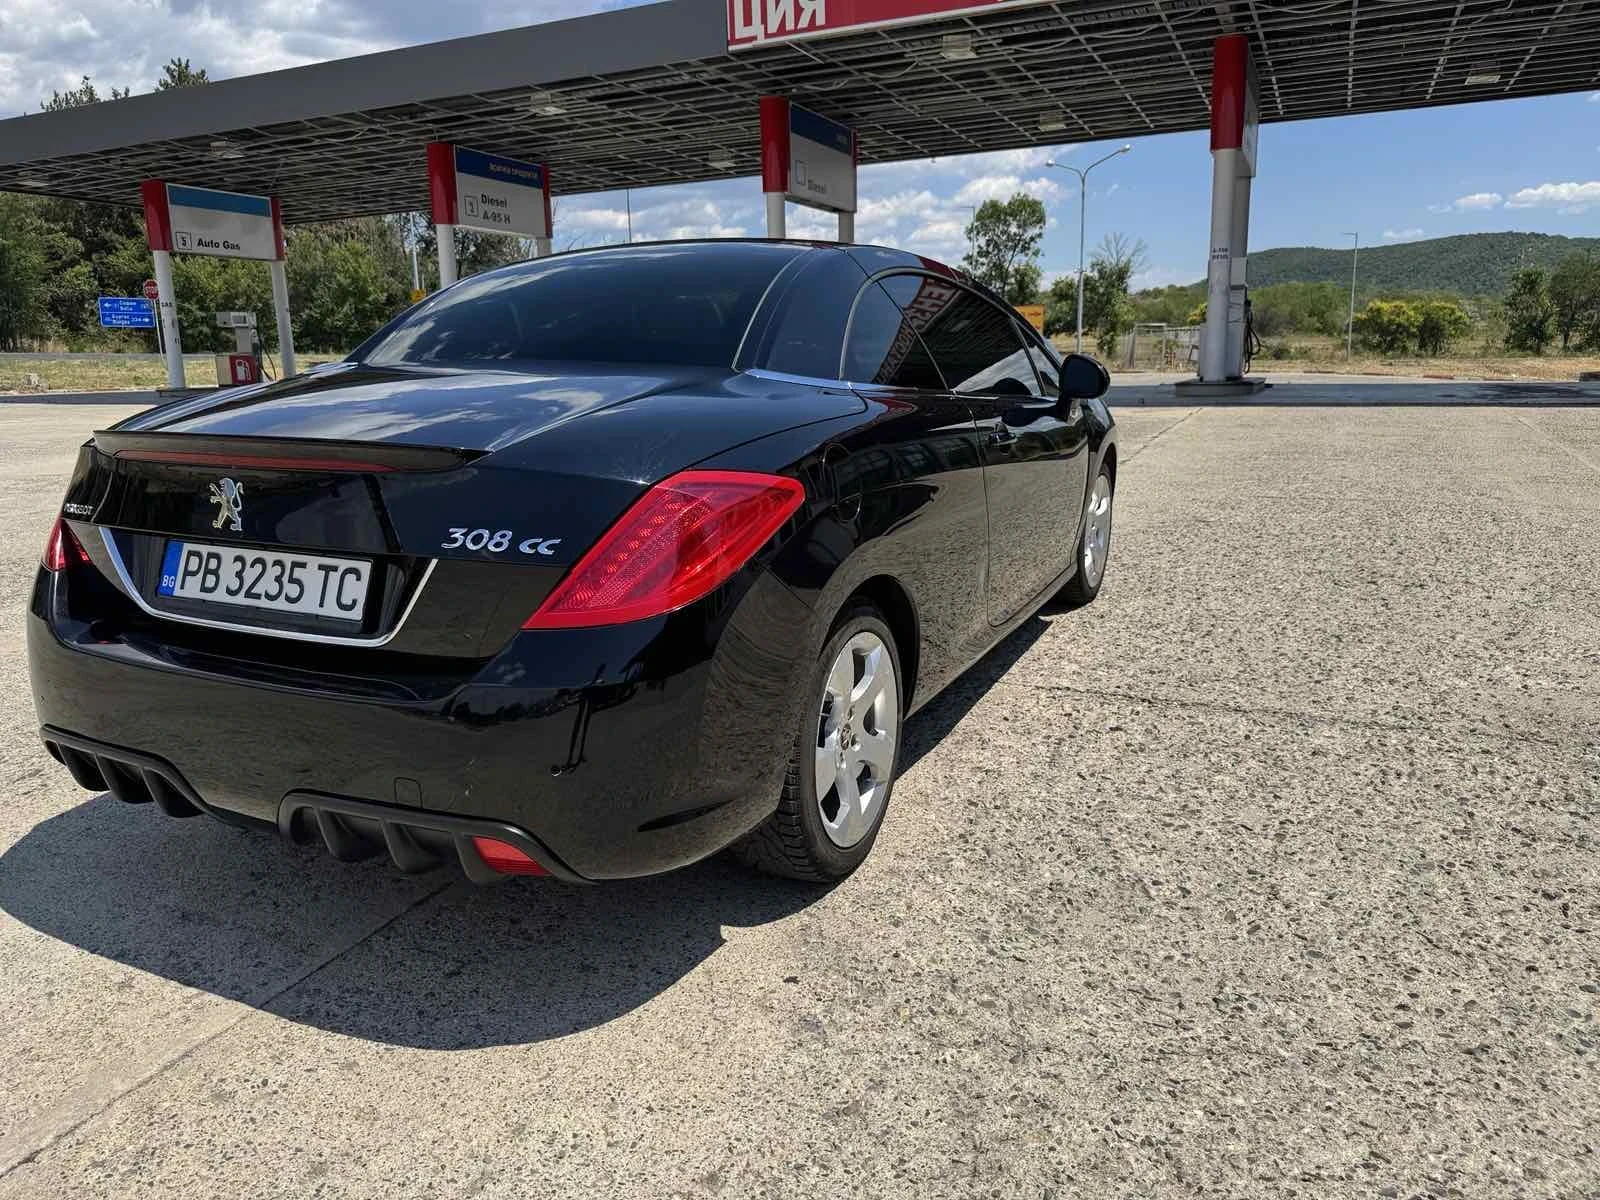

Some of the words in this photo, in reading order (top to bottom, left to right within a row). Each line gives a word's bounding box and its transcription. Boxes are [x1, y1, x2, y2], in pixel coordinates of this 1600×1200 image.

[481, 193, 508, 208] Diesel
[197, 238, 220, 249] Auto
[222, 240, 241, 251] Gas
[441, 528, 513, 552] 308
[161, 574, 176, 588] BG
[179, 550, 222, 594] PB
[225, 554, 308, 604] 3235
[315, 564, 362, 612] TC
